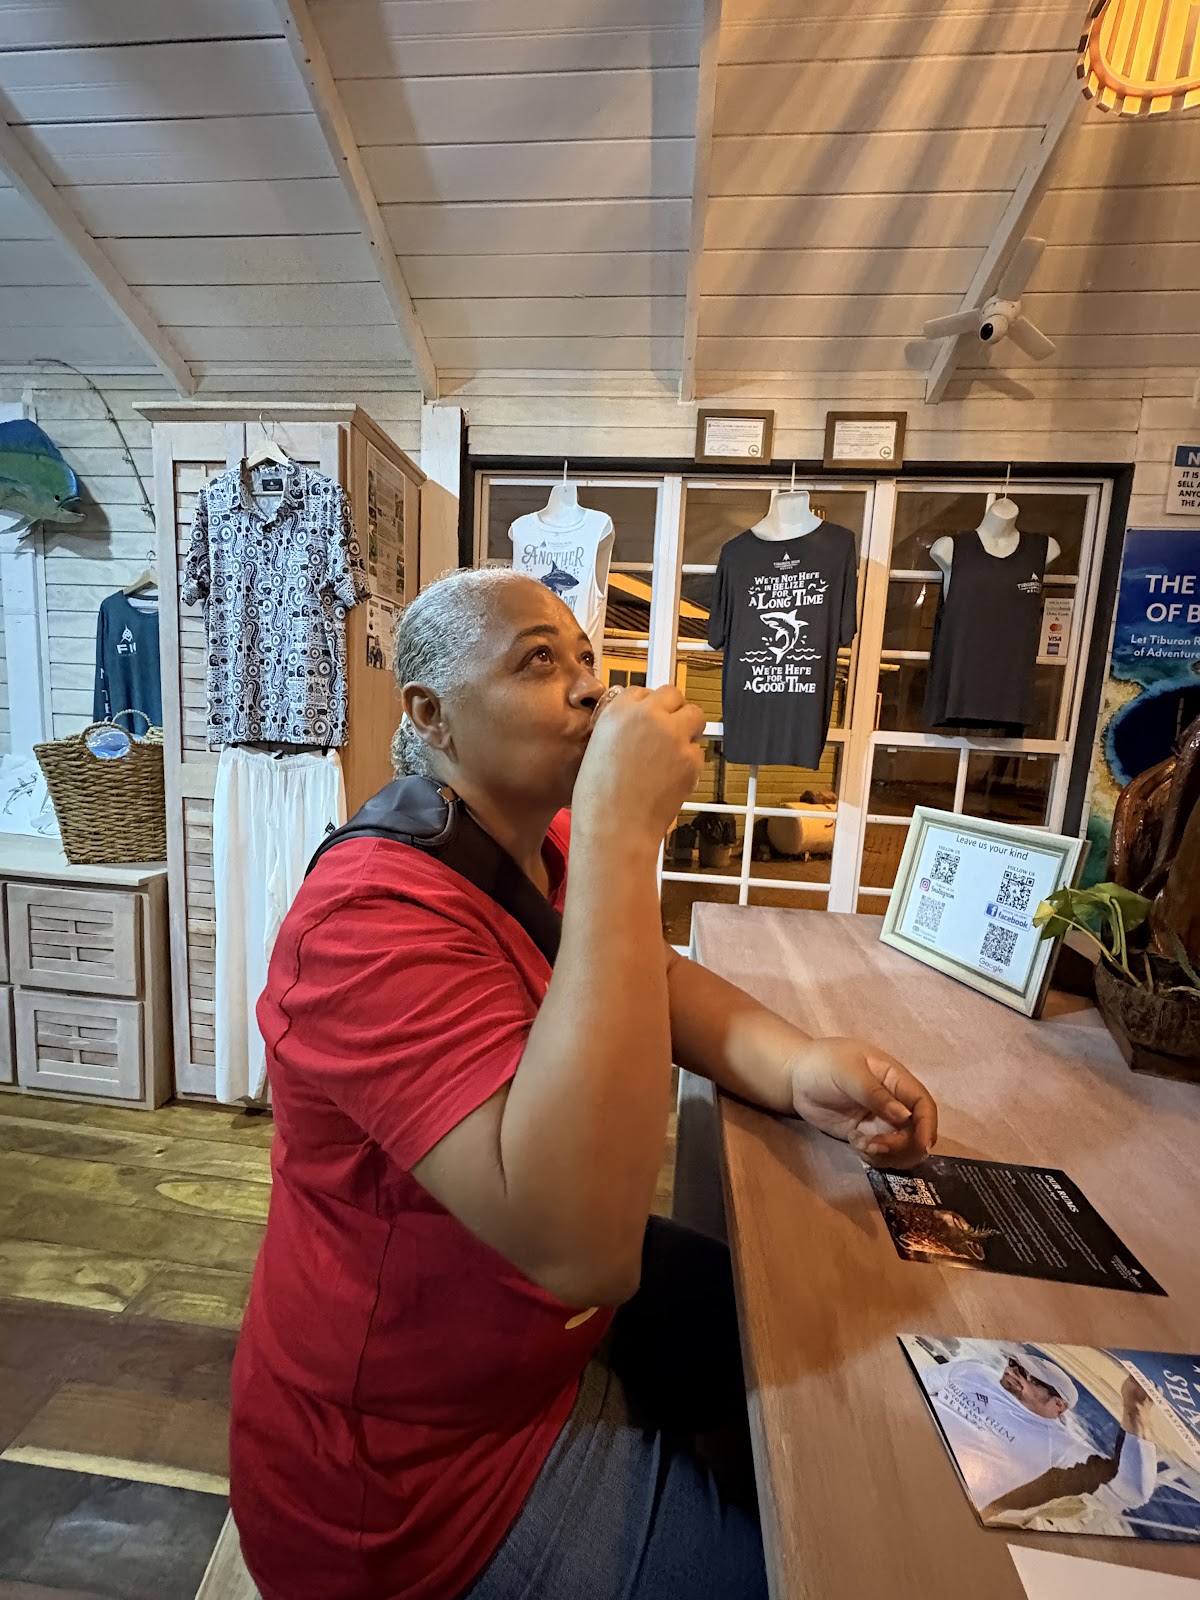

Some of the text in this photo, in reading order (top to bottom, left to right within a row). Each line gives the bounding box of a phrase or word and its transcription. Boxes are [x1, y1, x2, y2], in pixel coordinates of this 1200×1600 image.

[1192, 471, 1199, 479] IS
[1177, 480, 1194, 488] SELL
[772, 580, 805, 591] BELIZE
[1145, 574, 1197, 594] THE
[748, 596, 757, 607] A
[792, 588, 824, 607] TIME
[772, 590, 790, 598] FOR
[1146, 602, 1183, 623] OF
[1130, 634, 1147, 644] Let
[1150, 634, 1191, 645] Tiburon
[1134, 647, 1146, 657] of
[743, 680, 752, 690] A
[785, 676, 816, 693] TIME
[766, 675, 784, 683] FOR
[956, 834, 1029, 861] Leave us your kind
[1007, 864, 1028, 875] FOLLOW
[998, 911, 1028, 929] facebook
[979, 957, 1004, 974] Google
[1044, 1174, 1062, 1191] OUR
[1057, 1189, 1080, 1213] RUMS
[1164, 1408, 1196, 1447] TASTING
